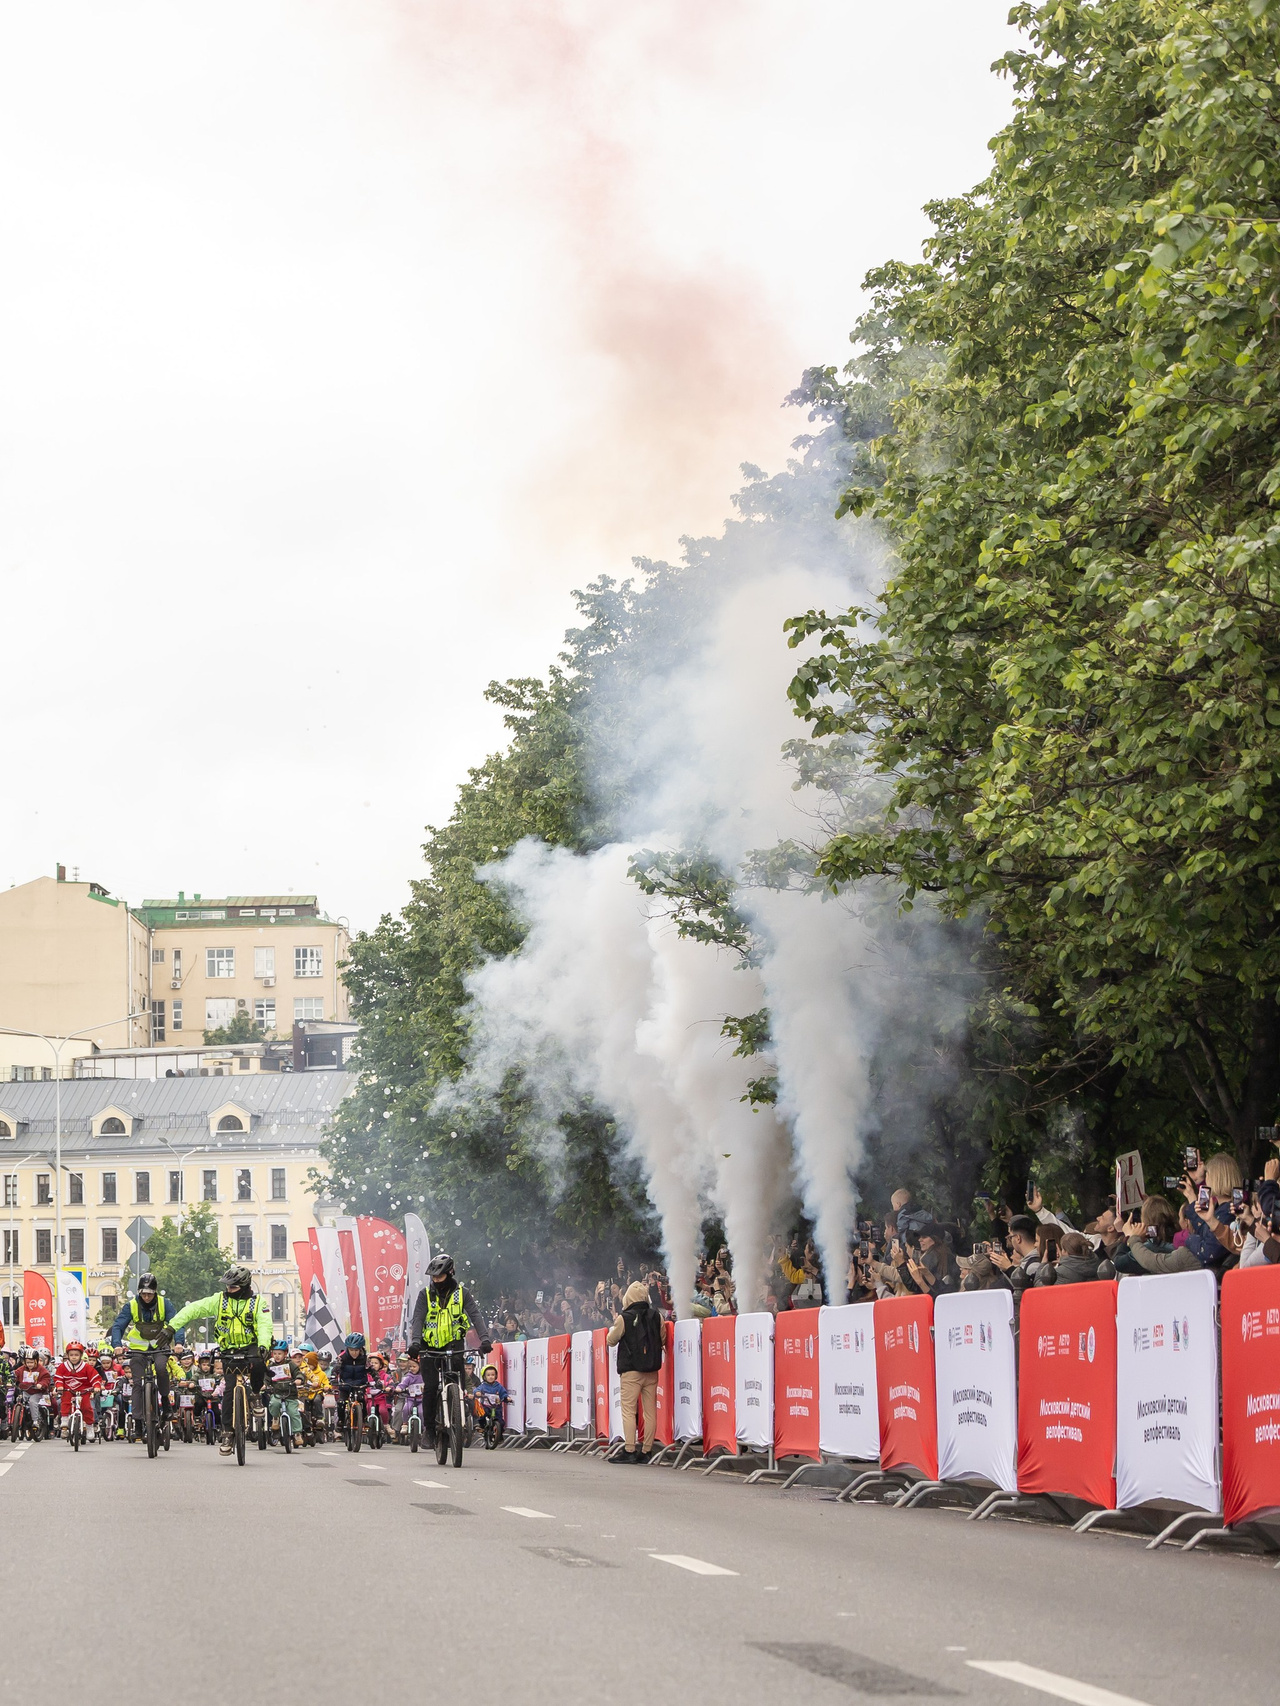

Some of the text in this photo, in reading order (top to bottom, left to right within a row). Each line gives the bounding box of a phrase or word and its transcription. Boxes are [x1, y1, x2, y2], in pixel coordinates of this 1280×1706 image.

[953, 1385, 992, 1408] Московский детский
[1137, 1394, 1188, 1420] Московский детский
[1247, 1394, 1280, 1418] Московски
[958, 1406, 987, 1427] велофестиваль
[1040, 1397, 1090, 1420] Московский детский
[1046, 1420, 1082, 1442] велофестиваль
[1144, 1420, 1180, 1444] велофестиваль
